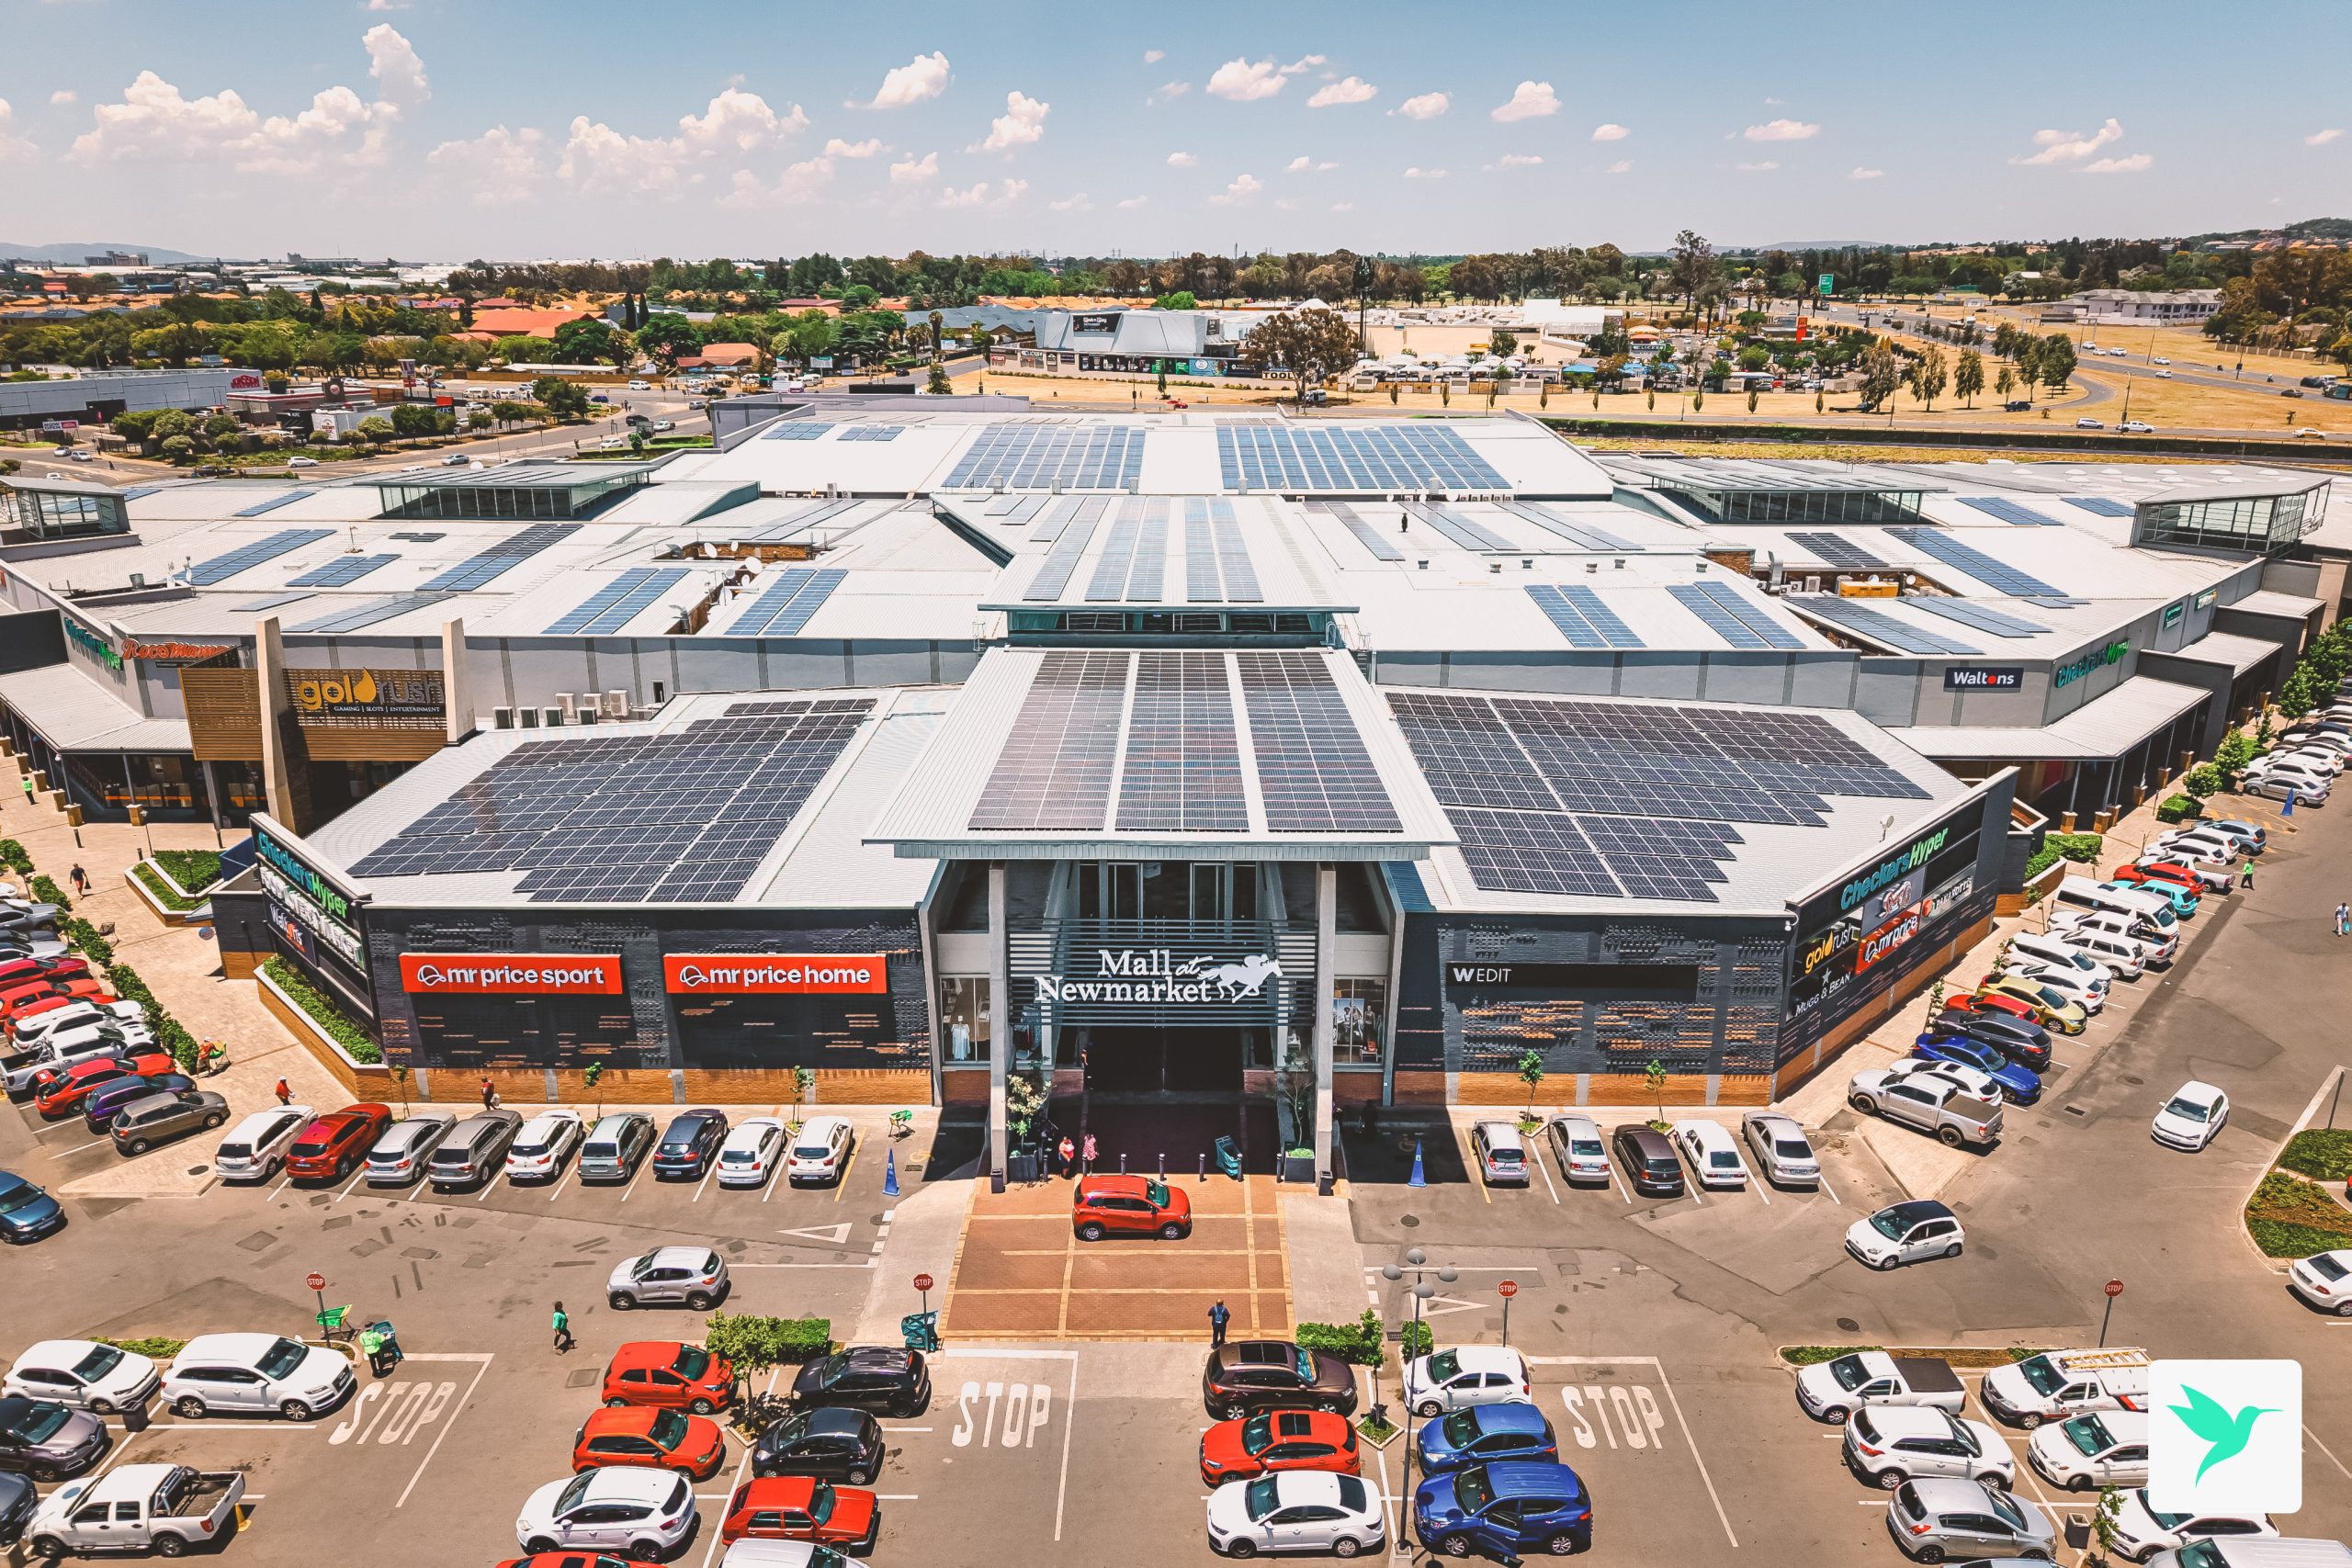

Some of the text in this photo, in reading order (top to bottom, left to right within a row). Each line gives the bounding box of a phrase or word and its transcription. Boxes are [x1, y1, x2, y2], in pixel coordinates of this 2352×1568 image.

[1953, 671, 2015, 686] Waltons
[258, 831, 347, 919] CheckersHyper
[1840, 828, 1949, 910] CheckersHyper
[1098, 949, 1214, 976] Mall at
[1453, 968, 1511, 983] W EDIT
[447, 965, 604, 987] mr price sport
[710, 965, 870, 987] mr price home
[1034, 976, 1212, 1002] Newmarket
[1795, 994, 1819, 1017] MUGG
[1829, 974, 1850, 995] BEAN
[307, 1278, 324, 1286] STOP
[1499, 1284, 1517, 1292] STOP
[2105, 1284, 2123, 1292] STOP
[328, 1382, 458, 1445] STOP
[952, 1382, 1052, 1448] STOP
[1561, 1385, 1665, 1450] STOP
